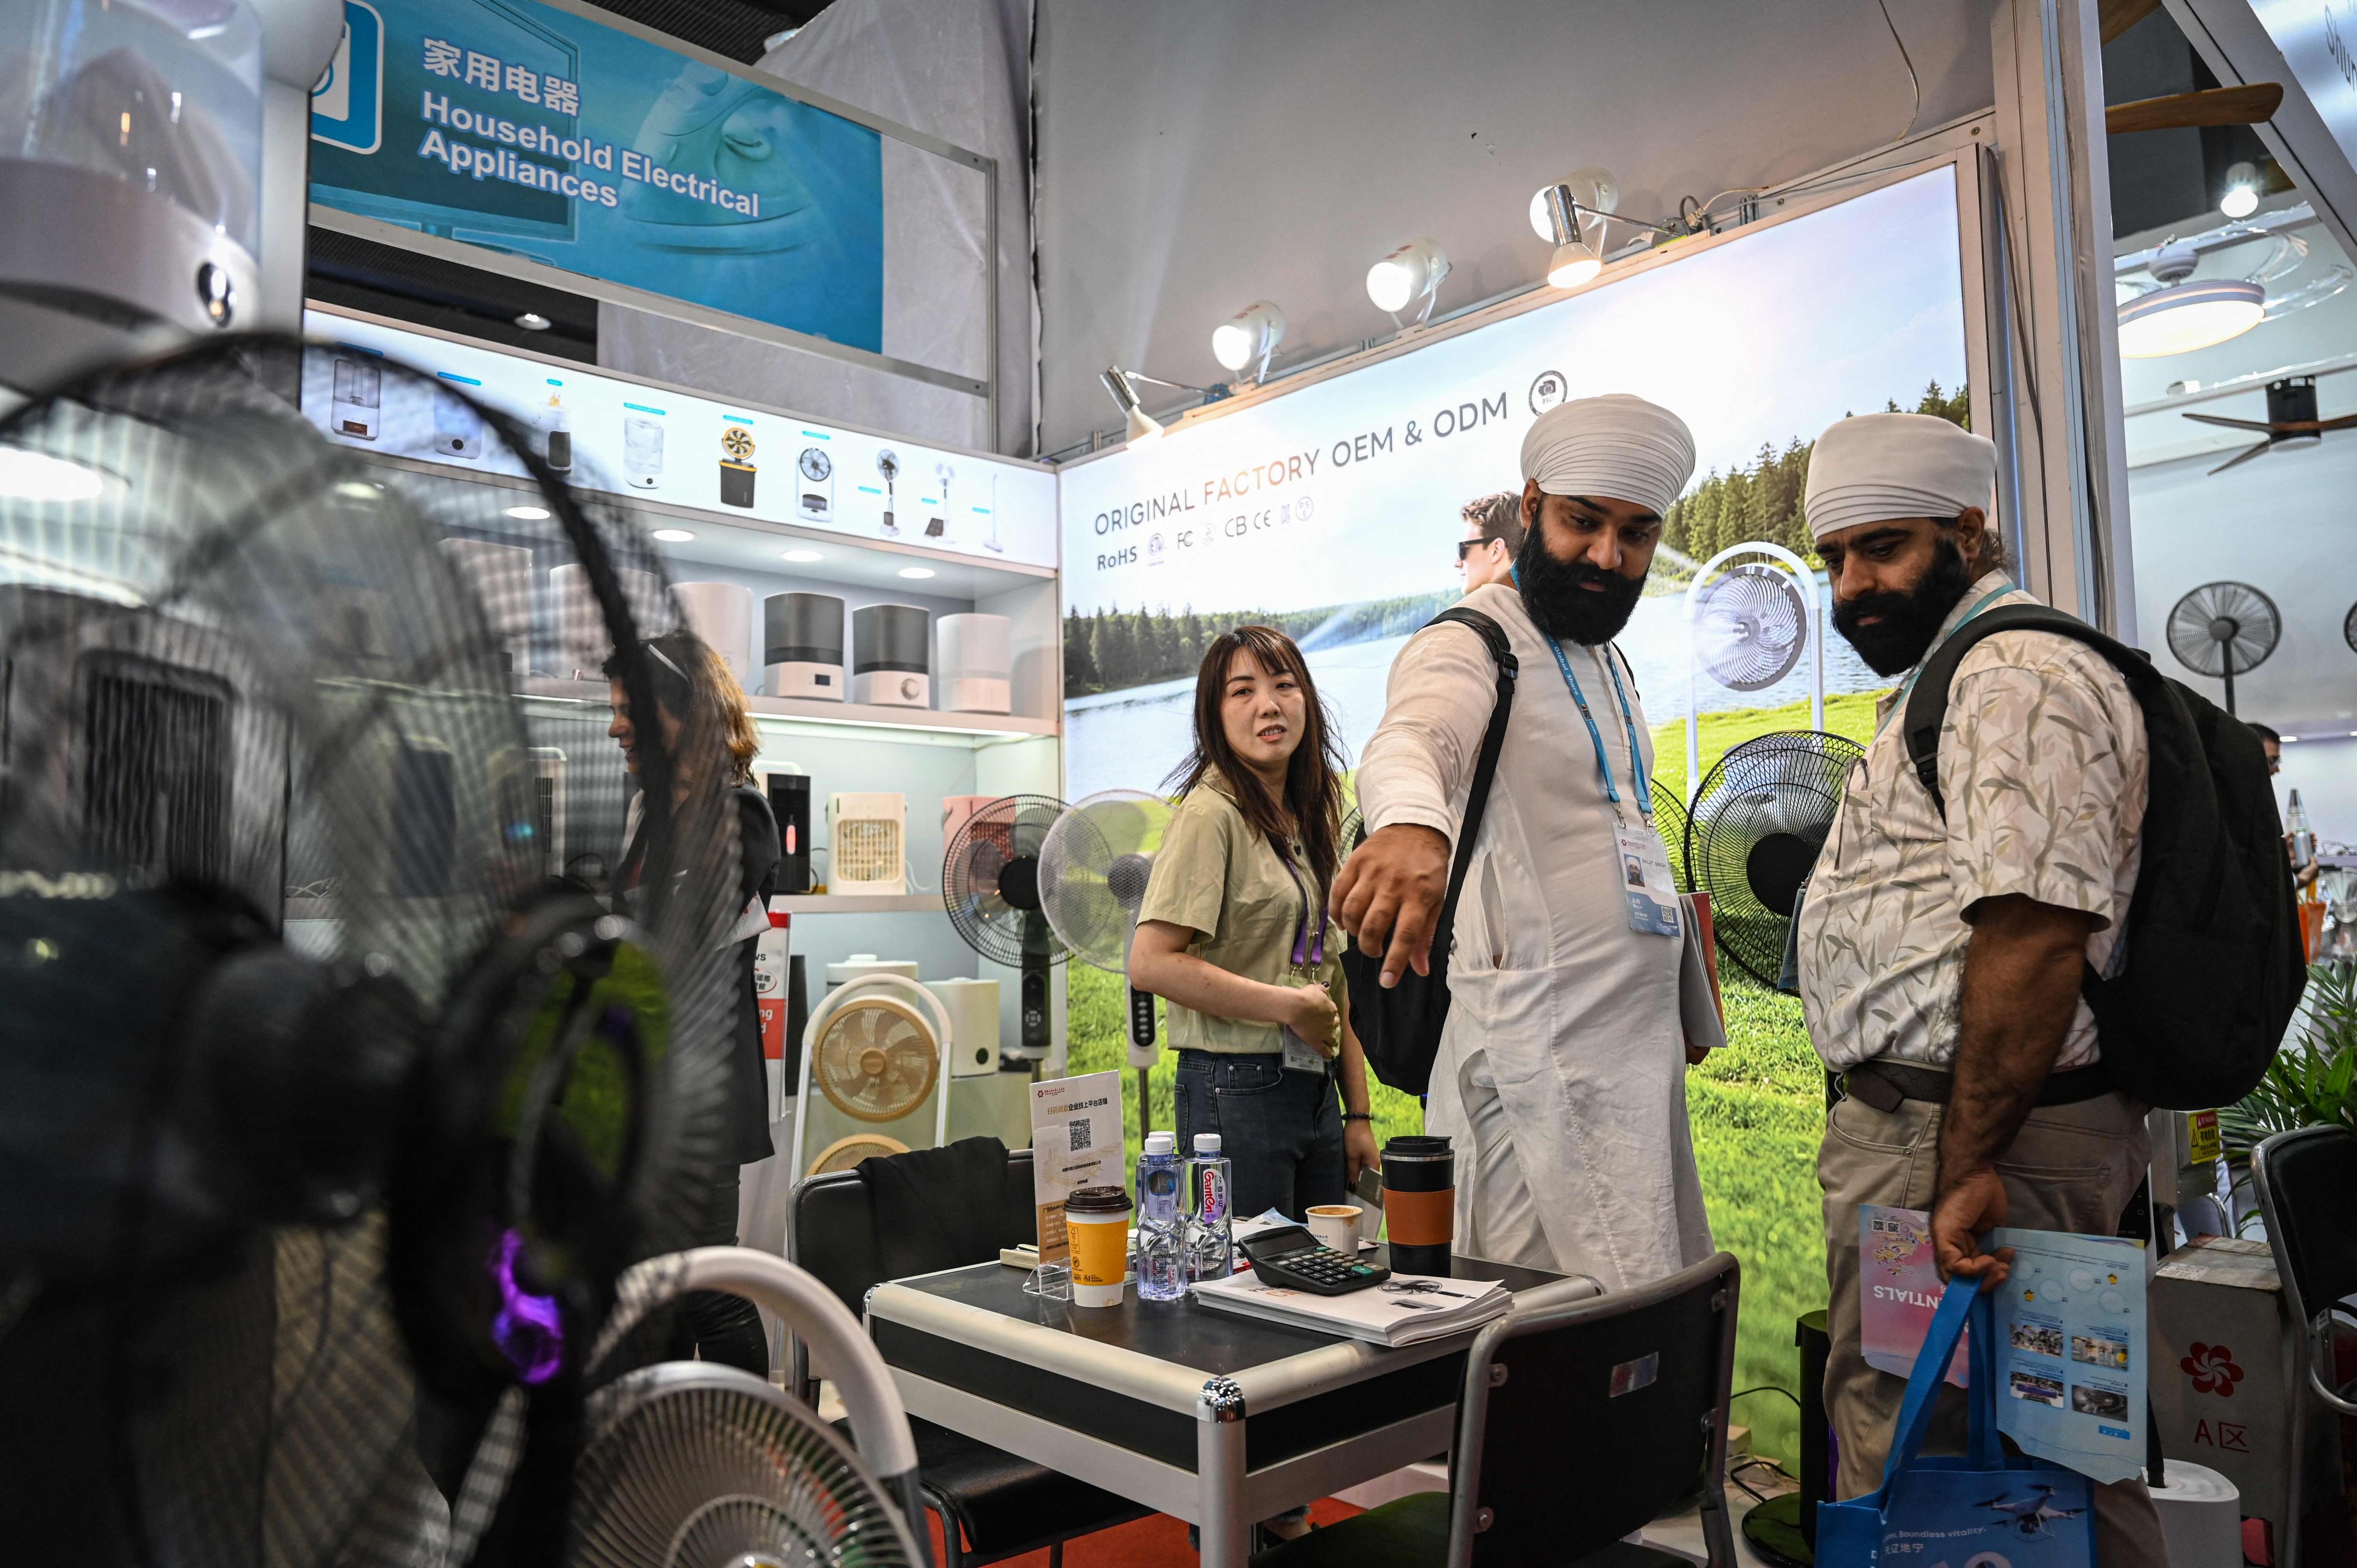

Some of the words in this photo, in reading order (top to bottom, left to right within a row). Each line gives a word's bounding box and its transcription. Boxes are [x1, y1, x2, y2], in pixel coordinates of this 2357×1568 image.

[422, 39, 579, 116] 家用电器
[421, 131, 617, 207] Appliances
[422, 90, 613, 171] Household
[622, 150, 759, 218] Electrical
[1095, 490, 1195, 535] ORIGINAL
[1204, 449, 1320, 505] FACTORY
[1332, 428, 1393, 467] OEM
[1405, 420, 1422, 446] &
[1433, 392, 1508, 438] ODM
[1098, 545, 1137, 571] RoHS
[1225, 515, 1247, 537] CB
[1253, 509, 1271, 530] CE
[1554, 646, 1569, 670] Global
[1567, 674, 1578, 696] Share
[1873, 1284, 1943, 1310] NTIALS
[1898, 1530, 1946, 1538] Boundless
[1947, 1526, 1987, 1538] vitality.
